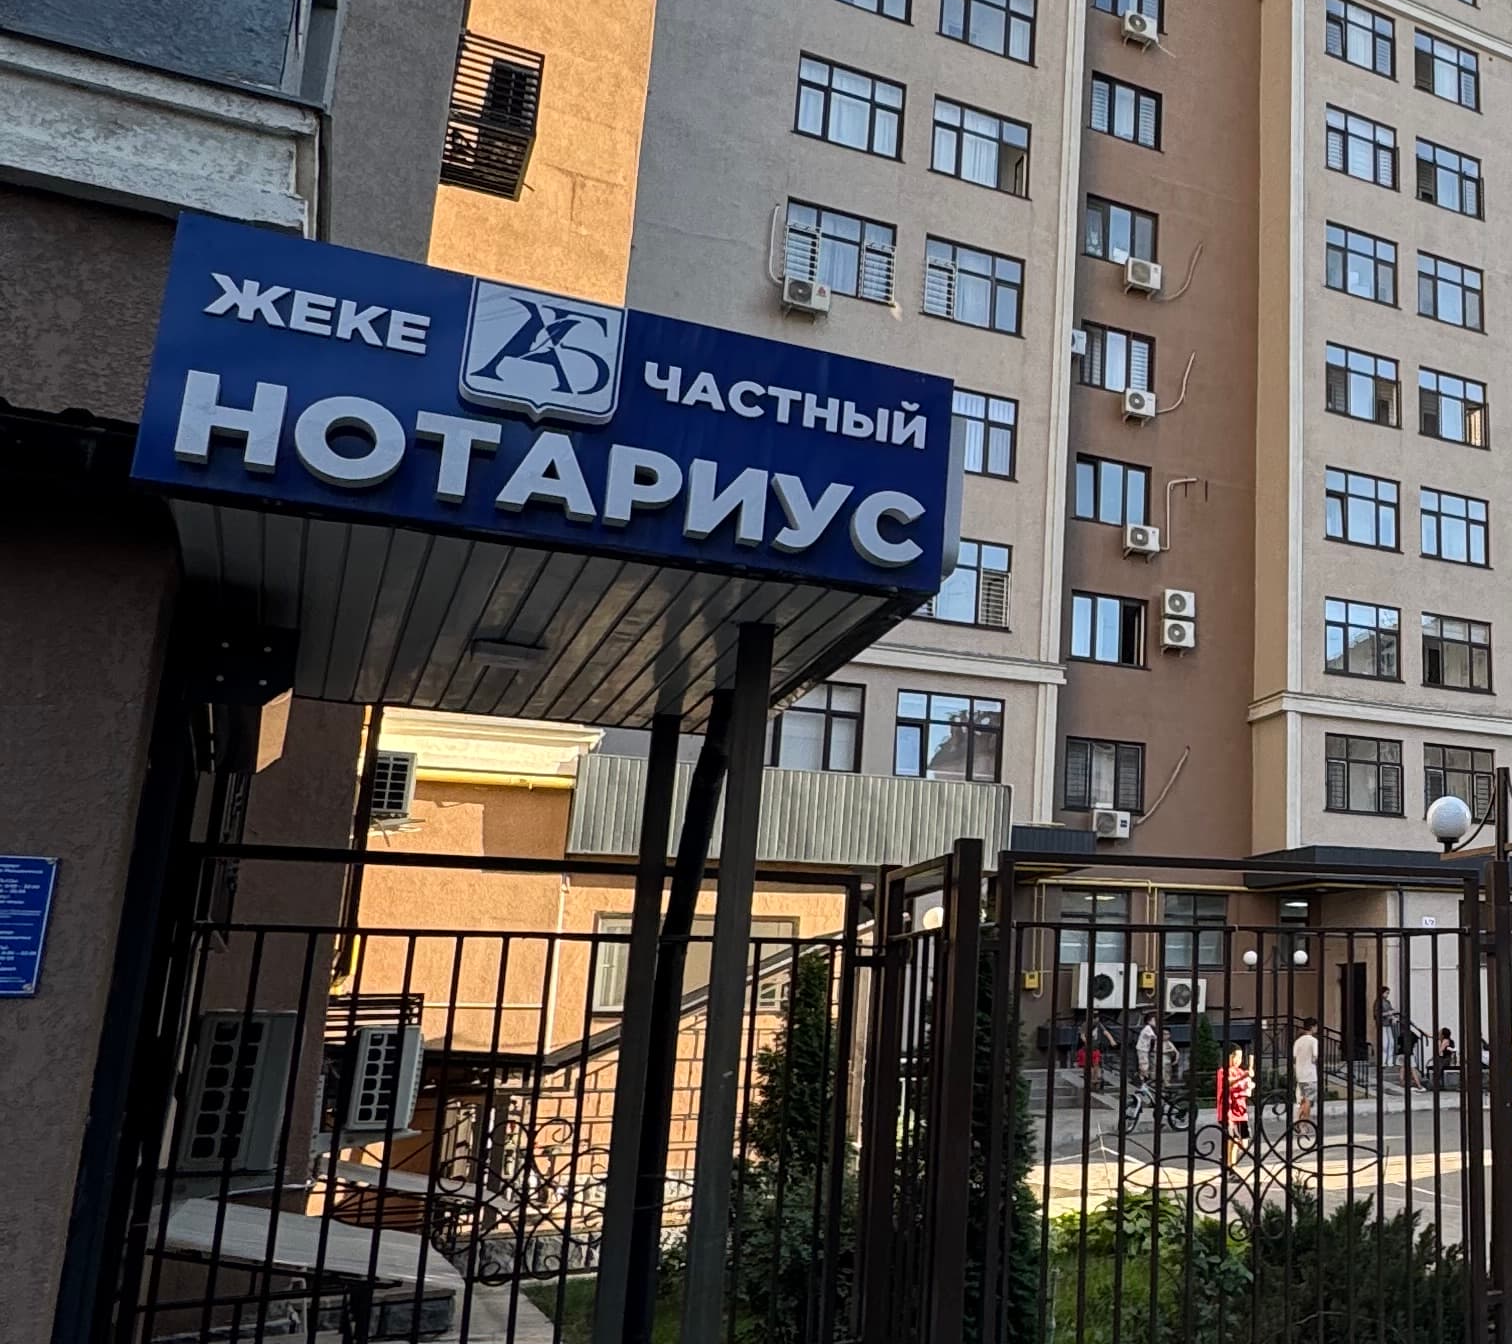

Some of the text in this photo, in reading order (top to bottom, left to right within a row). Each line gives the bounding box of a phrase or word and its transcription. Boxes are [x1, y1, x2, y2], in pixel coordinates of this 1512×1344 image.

[203, 273, 430, 353] ЖЕКЕ
[645, 361, 927, 449] ЧАСТНЫЙ
[174, 370, 924, 568] НОТАРИУС
